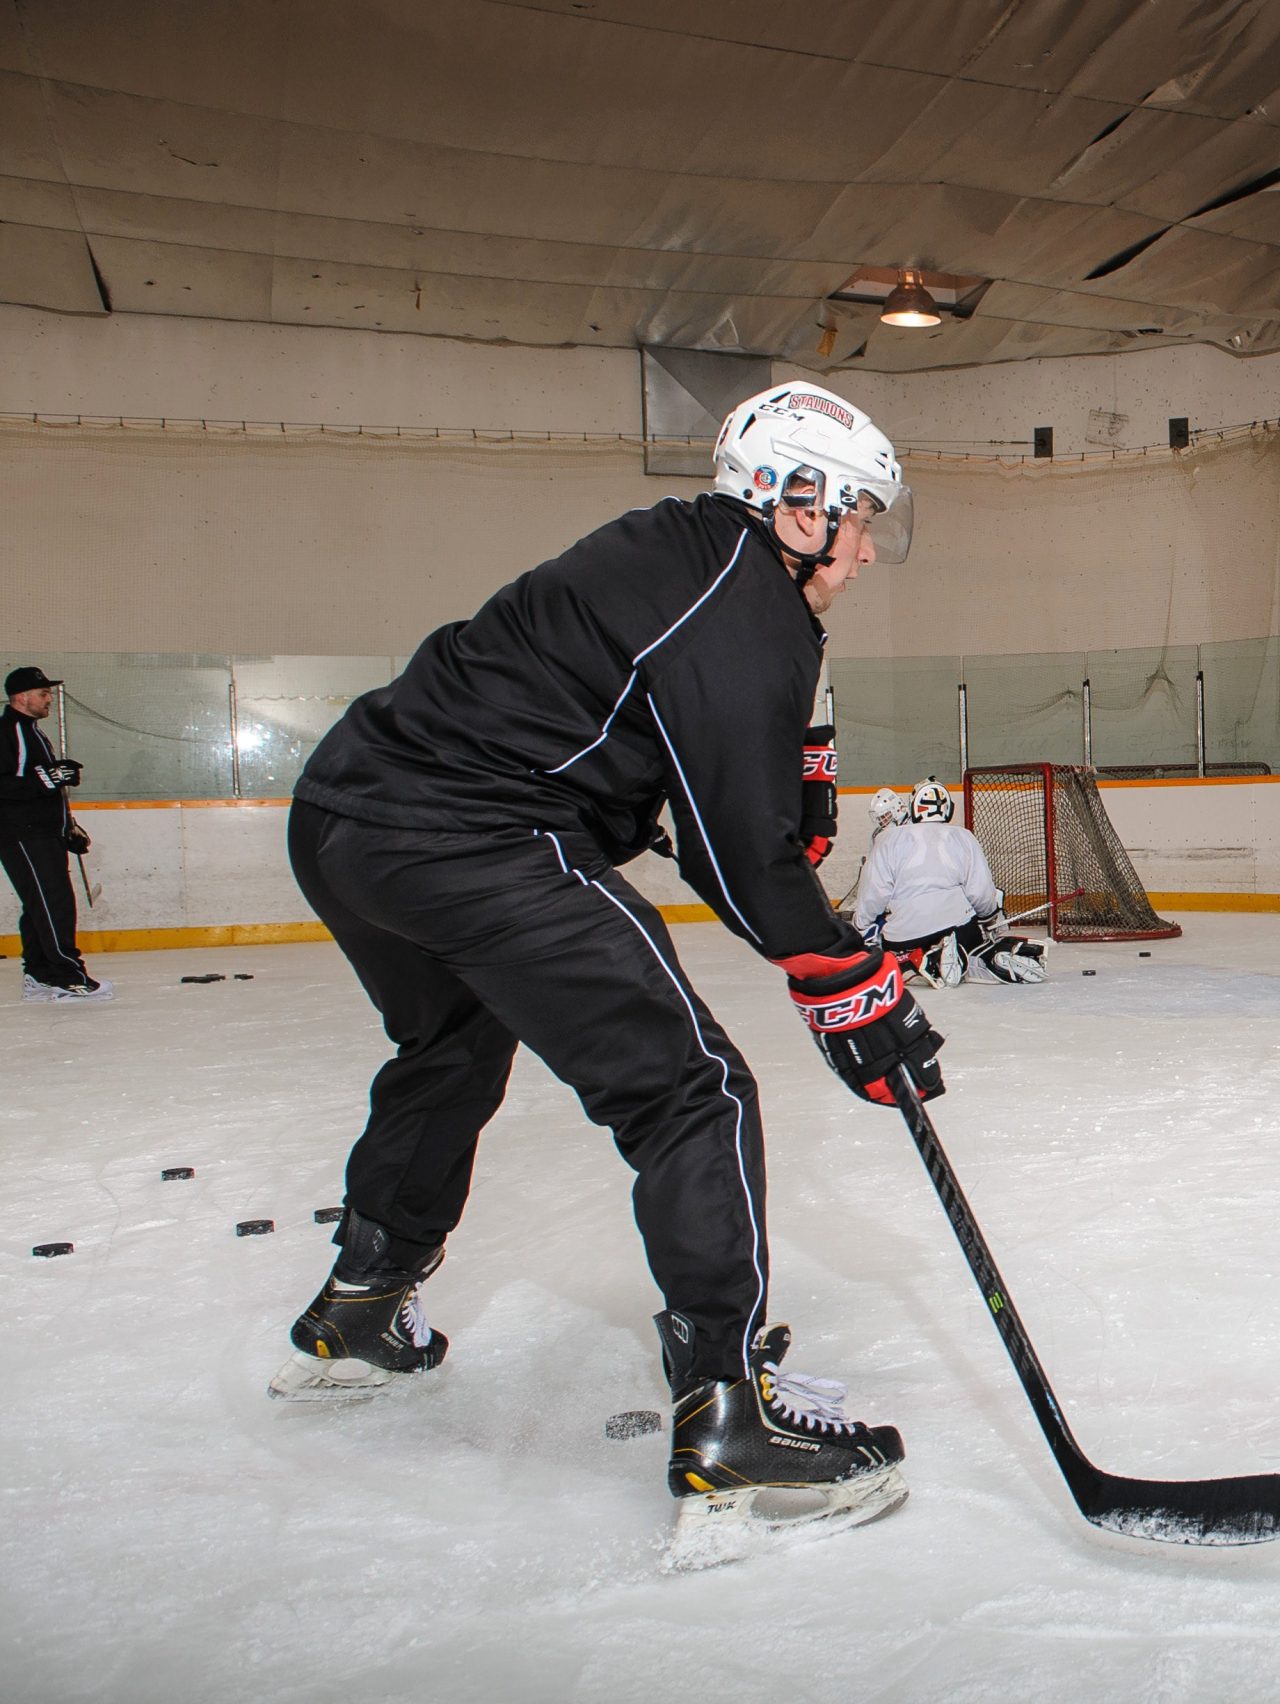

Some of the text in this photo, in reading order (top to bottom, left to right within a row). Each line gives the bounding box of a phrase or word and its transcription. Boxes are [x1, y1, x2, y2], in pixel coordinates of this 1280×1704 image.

[759, 404, 805, 421] CCM
[790, 395, 853, 428] STALLIONS
[380, 1332, 404, 1350] BAUER
[769, 1435, 821, 1452] BAUER
